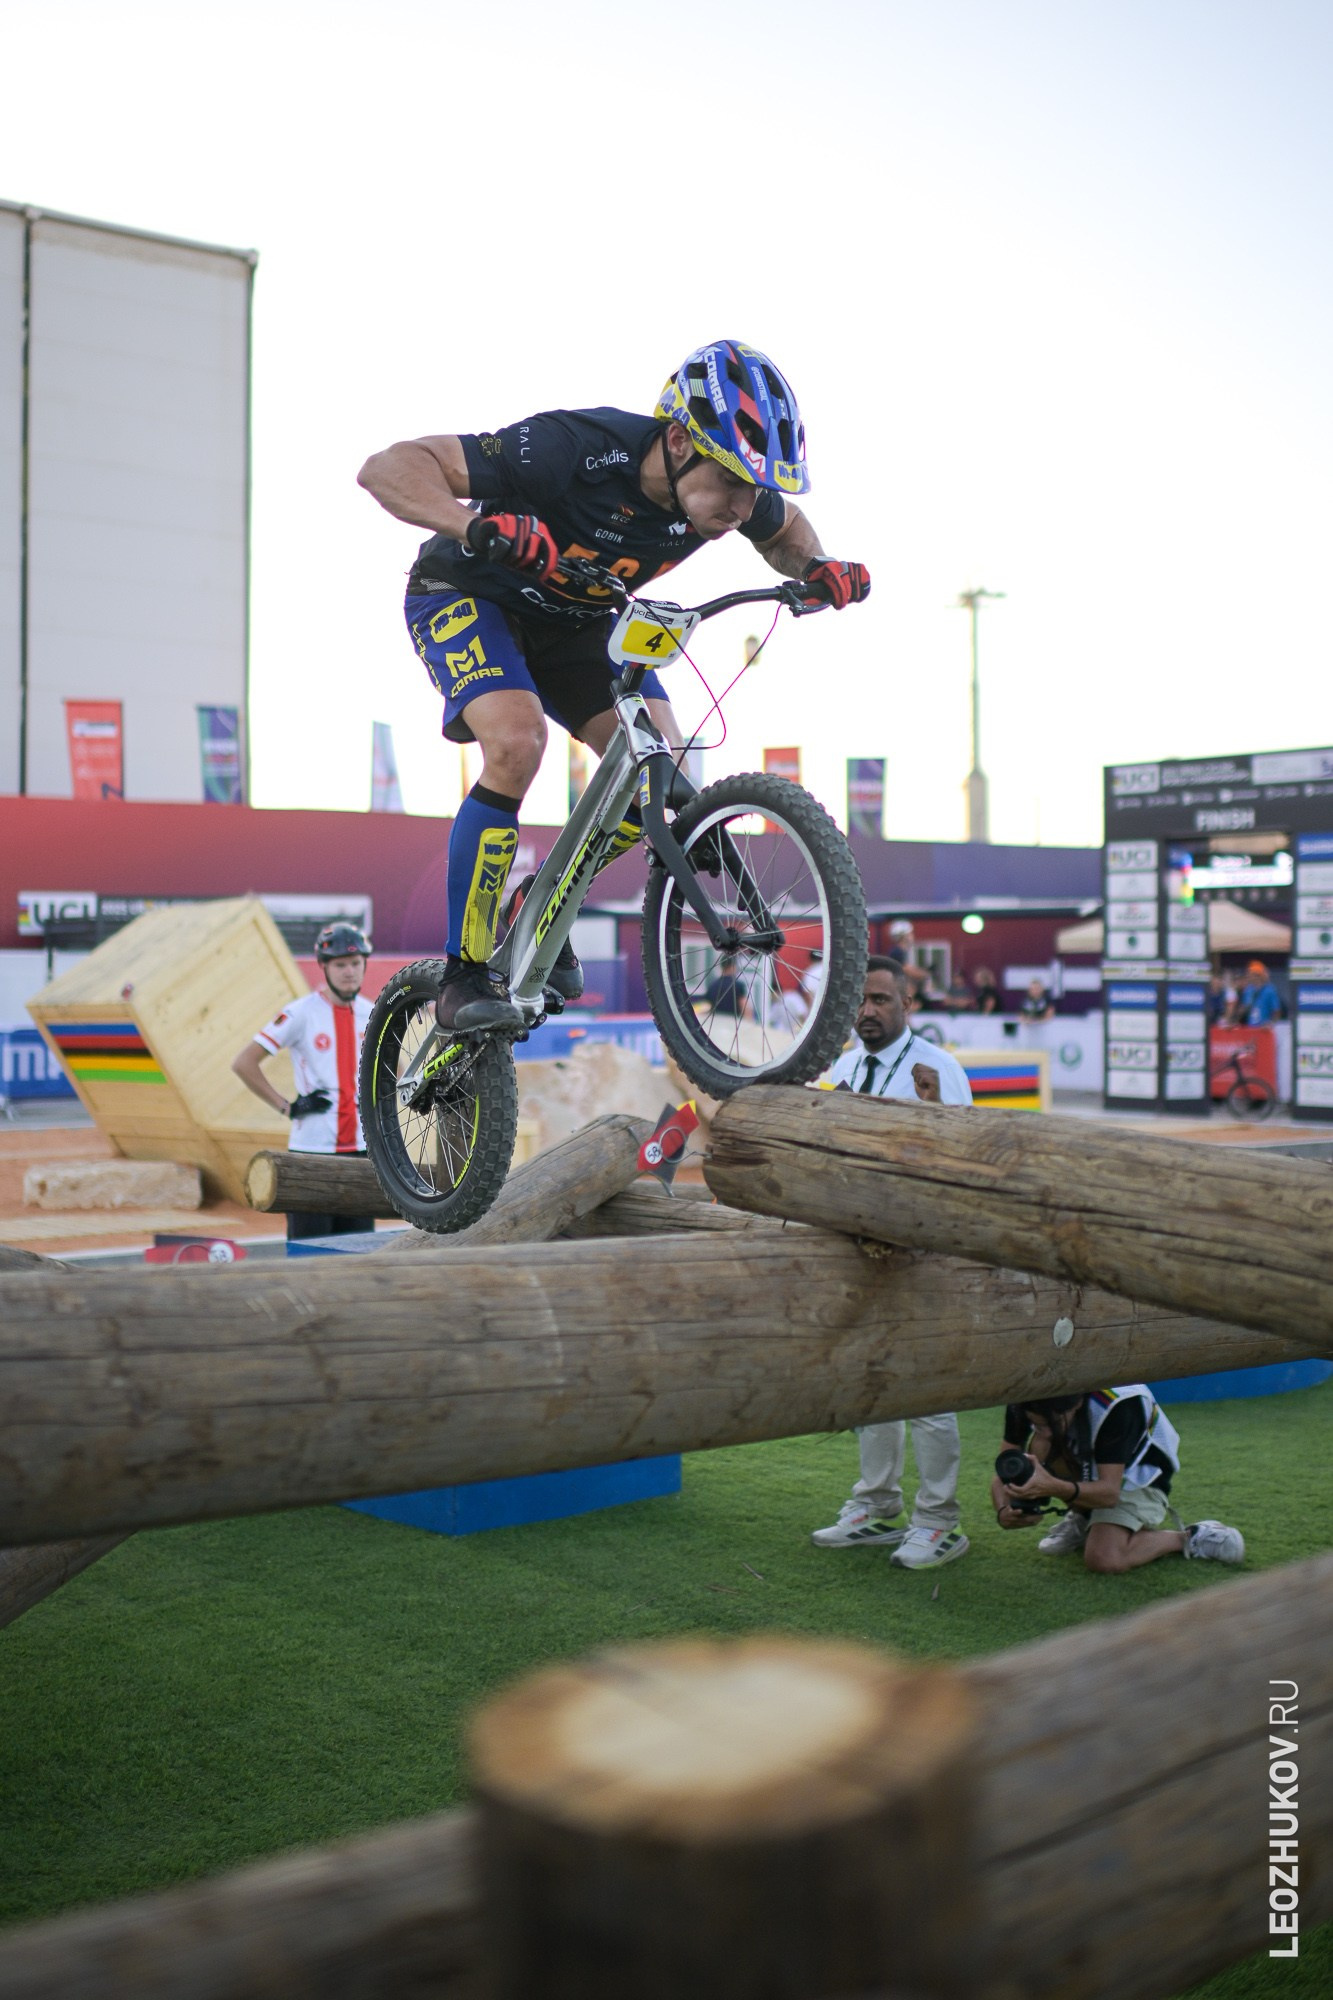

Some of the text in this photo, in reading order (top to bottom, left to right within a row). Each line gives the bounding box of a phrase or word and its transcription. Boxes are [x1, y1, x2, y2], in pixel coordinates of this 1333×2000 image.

[704, 350, 728, 415] COMAS
[519, 426, 531, 463] RALI
[595, 528, 625, 544] GOBIK
[433, 601, 474, 635] WD-40
[645, 632, 665, 652] 4
[451, 667, 504, 698] COMAS
[536, 824, 607, 948] COMAS
